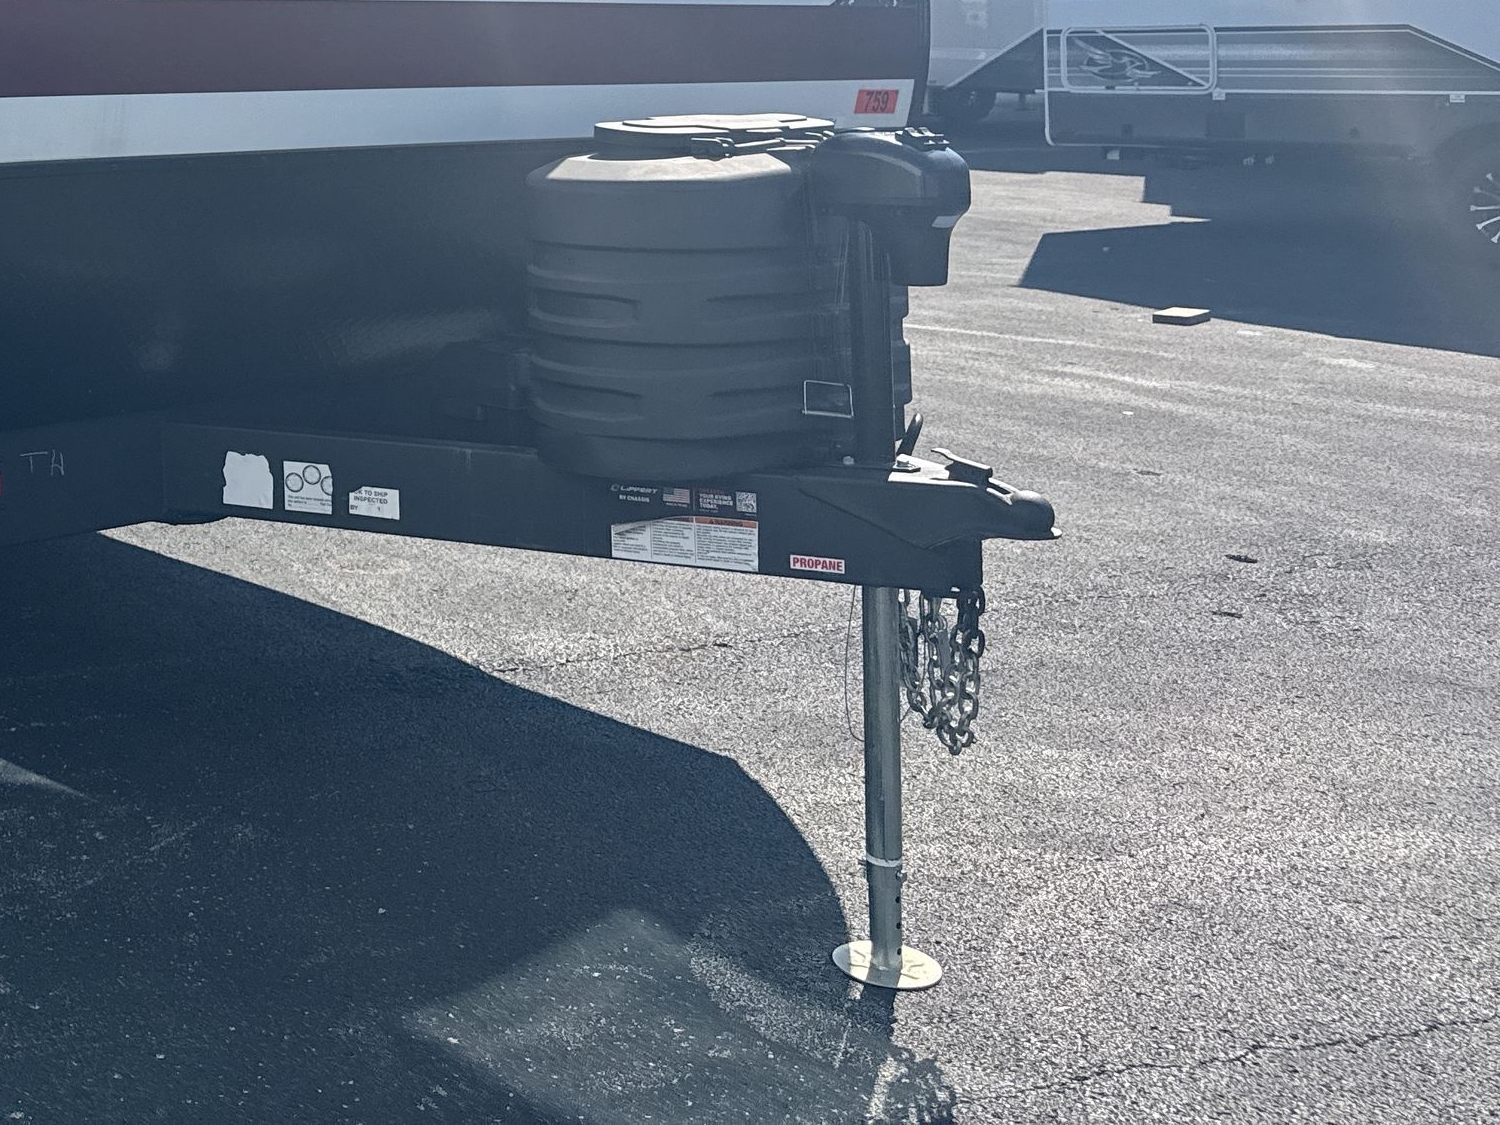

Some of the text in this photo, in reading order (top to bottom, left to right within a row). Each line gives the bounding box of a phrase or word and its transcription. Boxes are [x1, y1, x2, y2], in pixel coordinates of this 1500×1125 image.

[864, 89, 890, 113] 759
[353, 495, 388, 505] INSPECTED
[373, 490, 388, 498] SHIP
[792, 557, 843, 572] PROPANE
